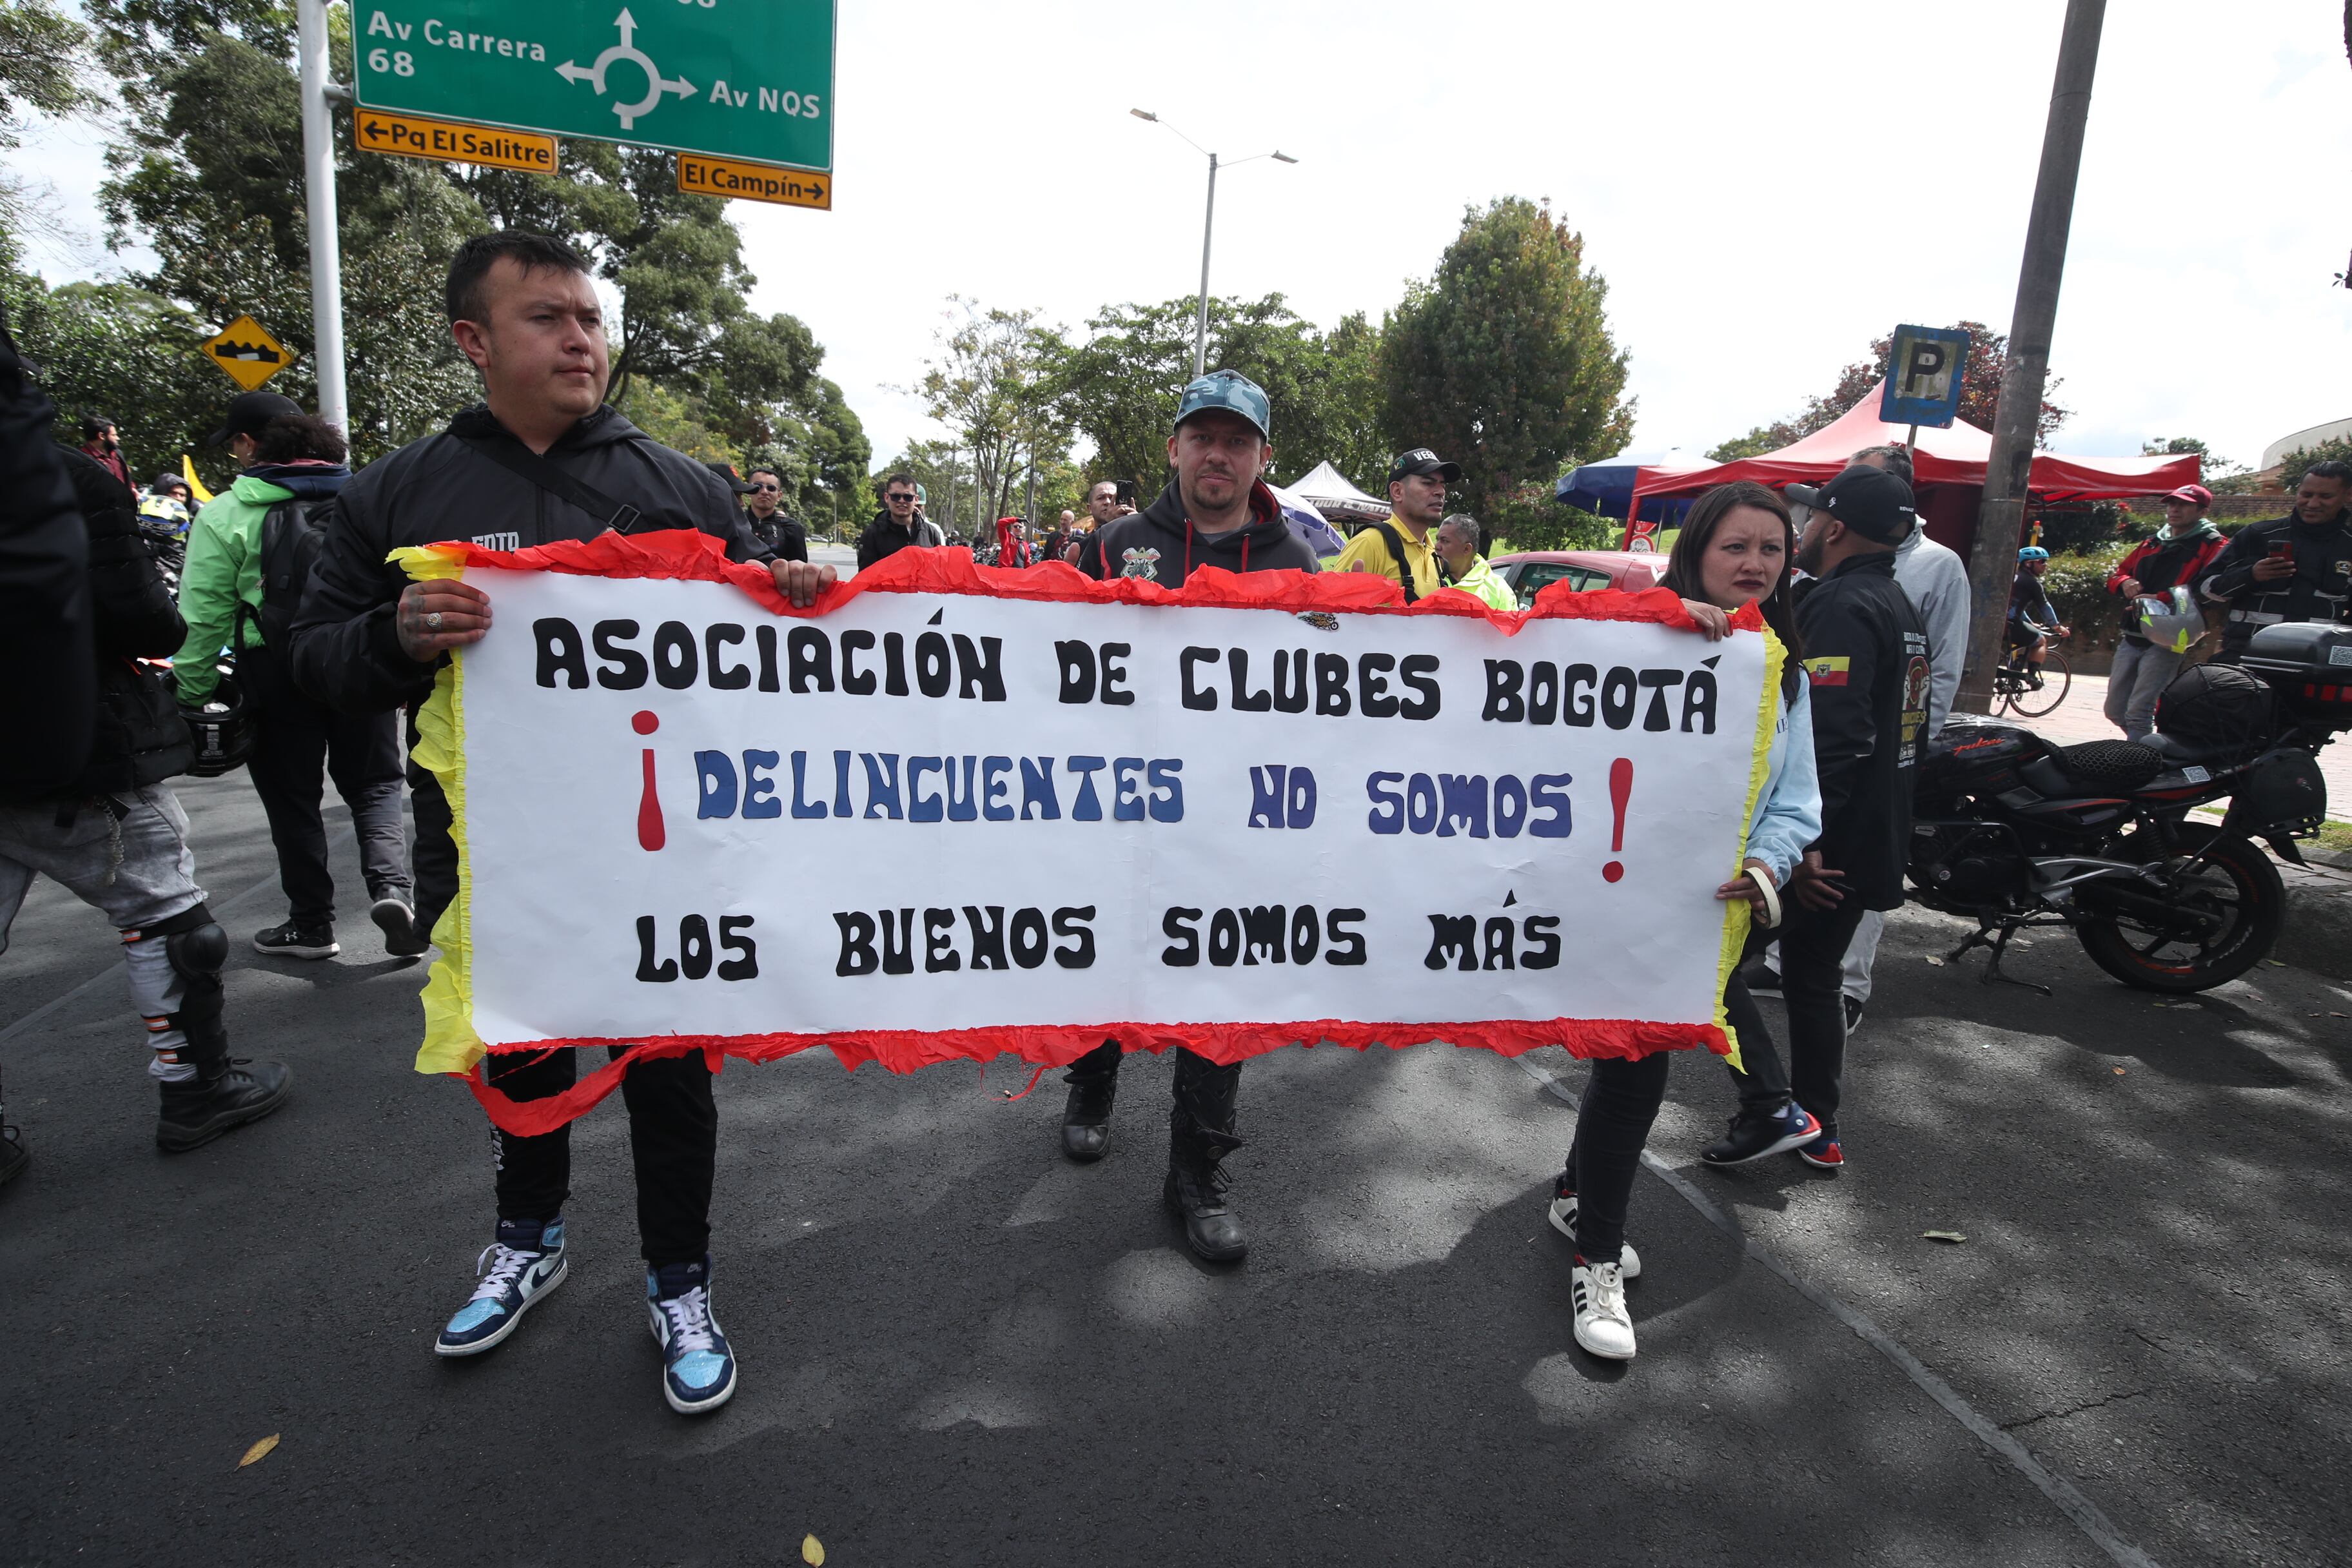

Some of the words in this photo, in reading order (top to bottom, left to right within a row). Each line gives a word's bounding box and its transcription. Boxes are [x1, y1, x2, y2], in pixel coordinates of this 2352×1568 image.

[367, 10, 413, 41] Av
[424, 19, 545, 62] Carrera
[368, 48, 415, 77] 68
[709, 80, 749, 108] Av
[759, 86, 820, 119] NQS
[391, 123, 426, 150] Pq
[433, 130, 456, 152] El
[462, 134, 549, 164] Salitre
[685, 163, 705, 185] El
[711, 168, 801, 198] Campín
[1905, 342, 1945, 393] P
[533, 607, 1007, 702] ASOCIACIÓN
[1055, 640, 1135, 706] DE
[1181, 647, 1441, 721] CLUBES
[1482, 654, 1721, 734] BOGOTÁ
[1248, 765, 1317, 829] NO
[636, 914, 759, 983] LOS
[832, 905, 1096, 977] BUENOS
[1162, 904, 1367, 967] SOMOS
[1424, 890, 1562, 971] MÁS
